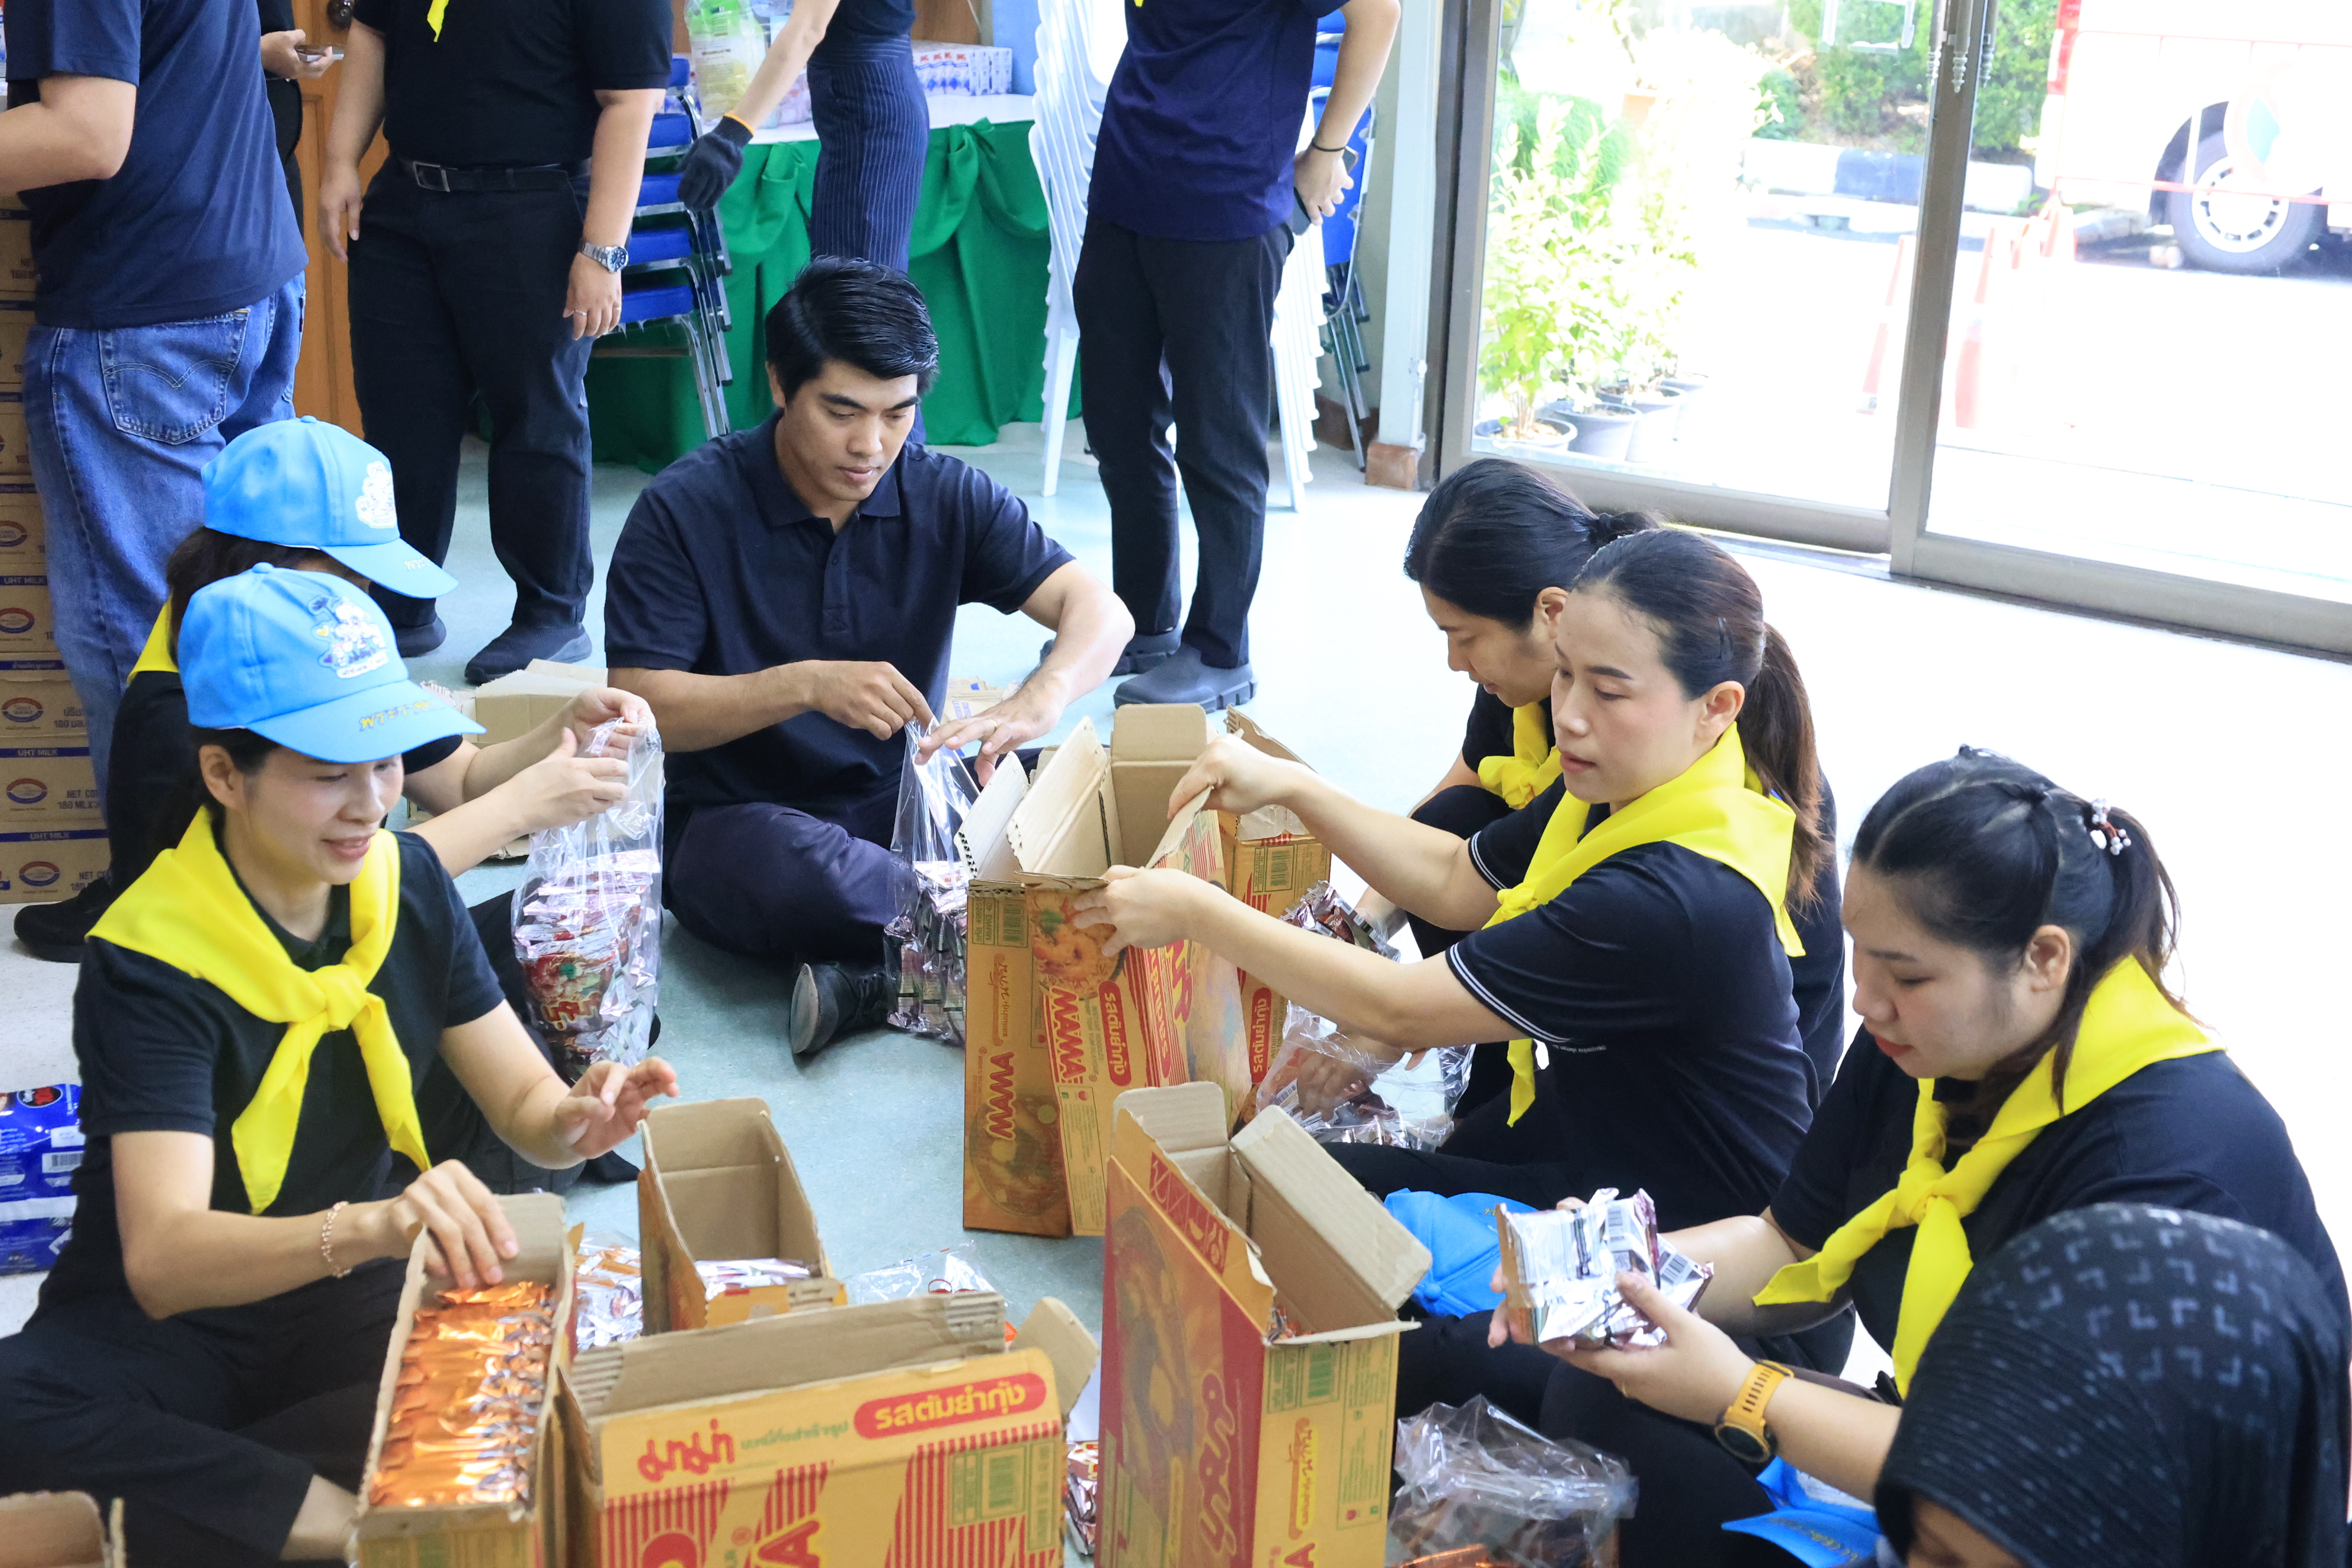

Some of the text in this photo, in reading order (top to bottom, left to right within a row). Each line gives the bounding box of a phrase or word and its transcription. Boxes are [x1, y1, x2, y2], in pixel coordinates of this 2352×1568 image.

[58, 801, 73, 809] 180
[67, 789, 81, 798] NET
[79, 871, 93, 880] NET
[986, 903, 992, 912] 40
[1051, 987, 1087, 1079] MAMA
[1104, 992, 1127, 1076] รสต้มยำกุ้ง
[1252, 998, 1270, 1073] รสต้มยำกุ้ง
[988, 1051, 1015, 1139] MAMA
[875, 1380, 1027, 1430] รสต้มยำกุ้ง
[638, 1418, 735, 1482] มาม่า
